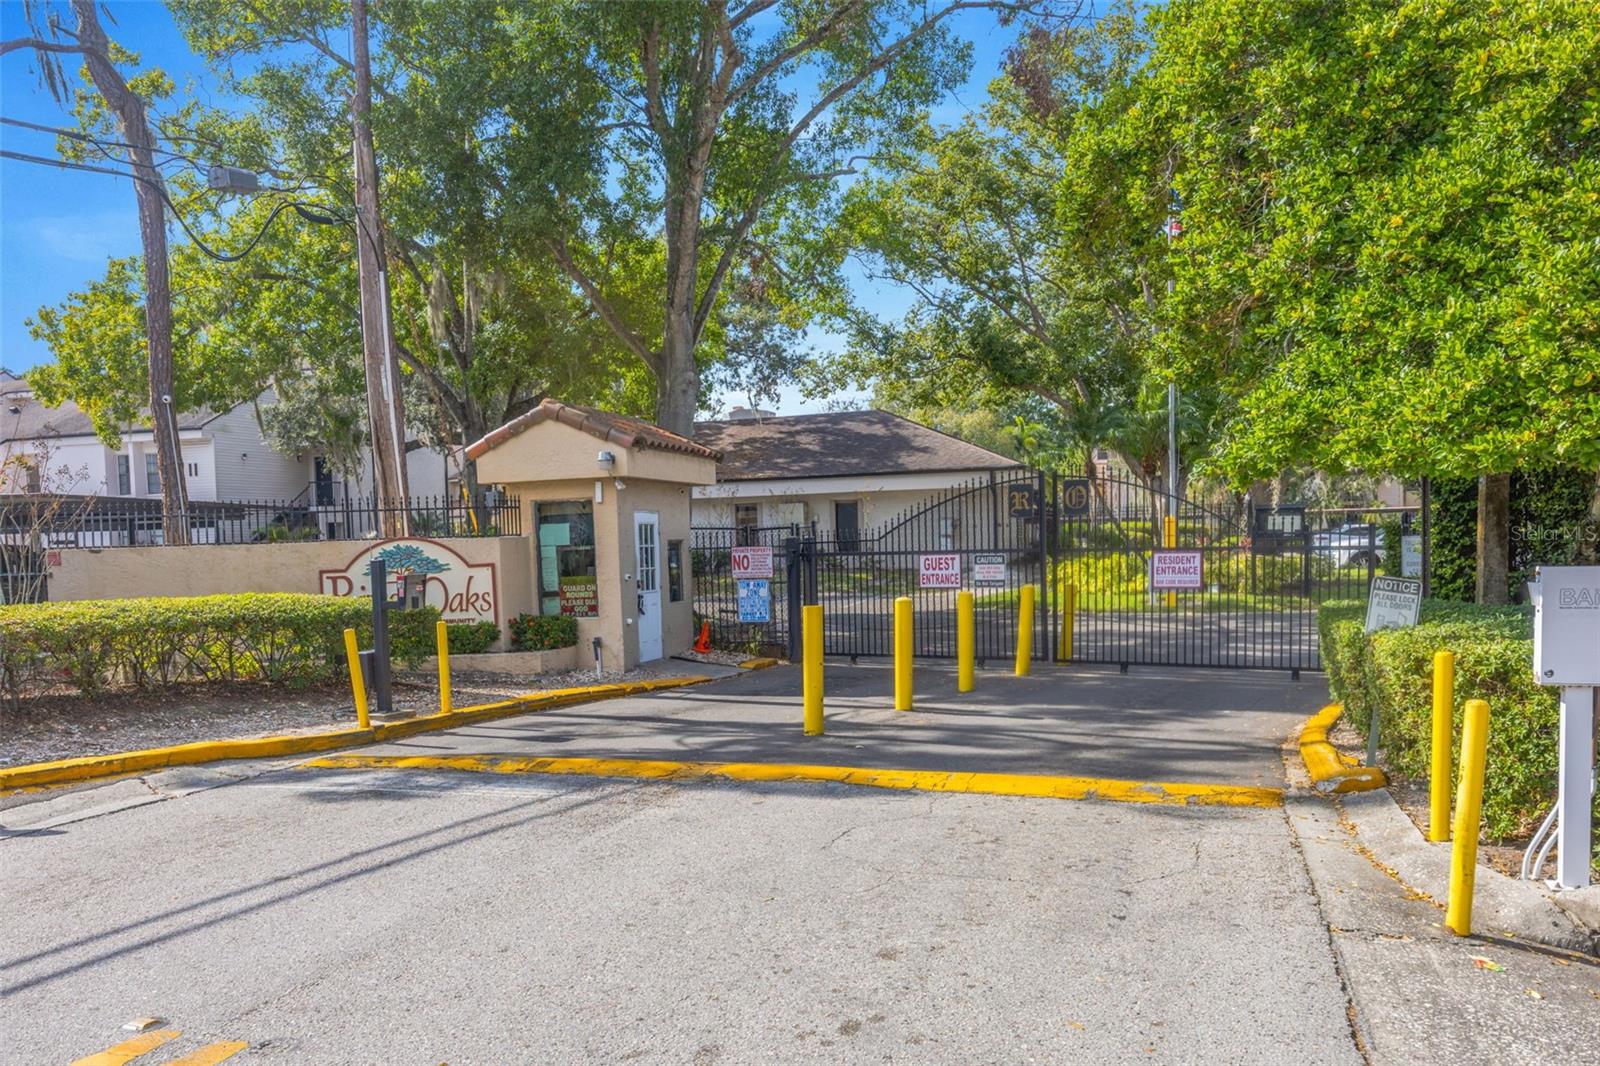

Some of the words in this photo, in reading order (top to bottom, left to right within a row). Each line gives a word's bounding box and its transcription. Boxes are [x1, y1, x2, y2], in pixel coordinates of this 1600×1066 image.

[1010, 491, 1029, 514] R
[1065, 485, 1087, 509] O
[733, 555, 750, 571] NO
[924, 557, 956, 571] GUEST
[976, 556, 1003, 564] CAUTION
[1157, 556, 1196, 565] RESIDENT
[1156, 566, 1199, 575] ENTRANCE
[921, 573, 959, 585] ENTRANCE
[563, 584, 585, 592] GUARD
[1375, 579, 1419, 593] NOTICE
[1374, 592, 1397, 601] PLEASE
[1376, 600, 1388, 608] ALL
[1389, 602, 1412, 611] DOORS
